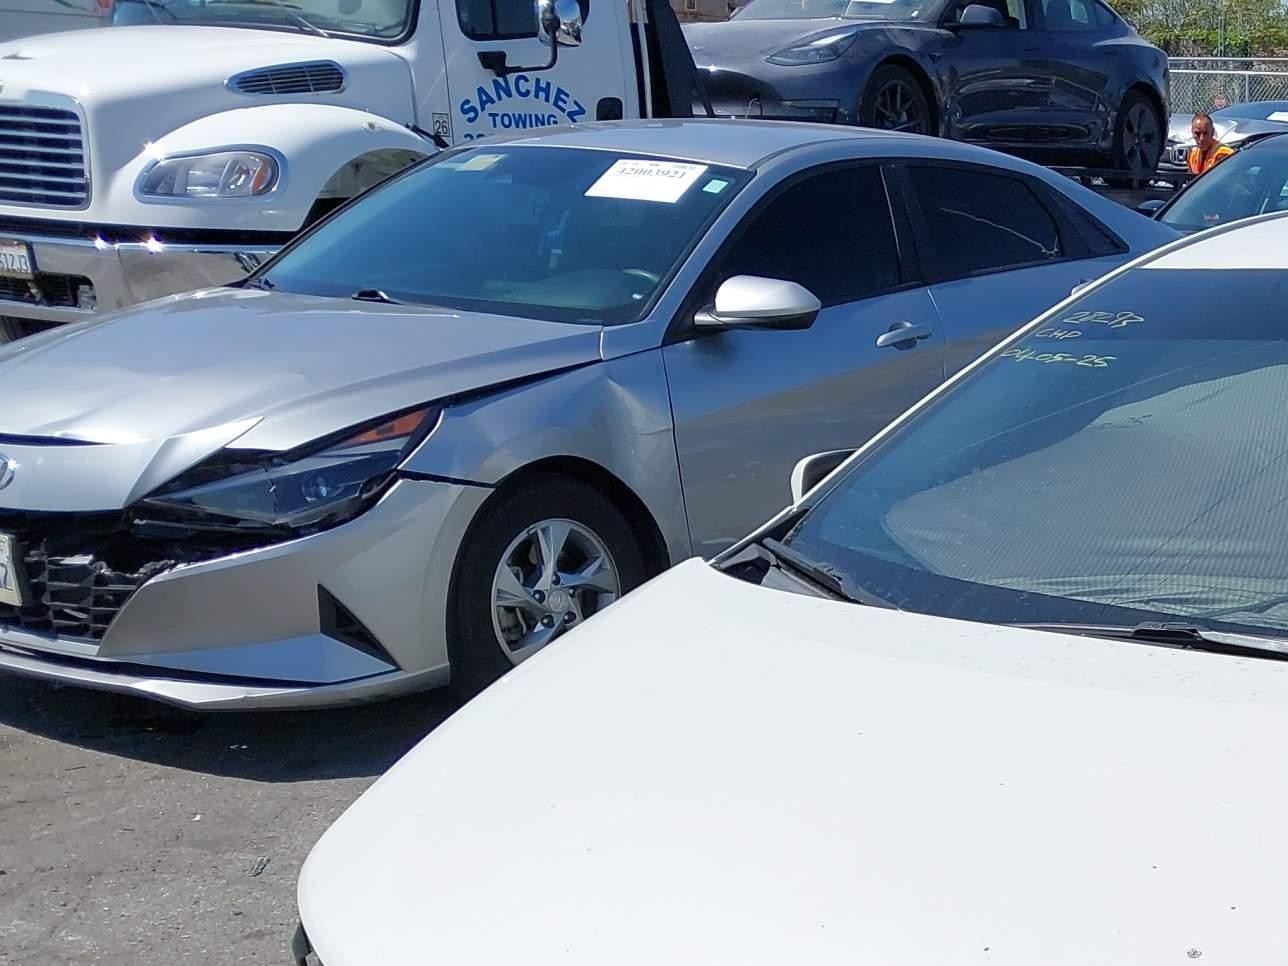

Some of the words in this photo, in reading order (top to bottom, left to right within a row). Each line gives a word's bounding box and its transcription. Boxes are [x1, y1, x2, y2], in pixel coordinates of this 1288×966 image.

[460, 74, 586, 124] SANCHEZ
[434, 119, 448, 135] 26
[488, 112, 558, 129] TOWING
